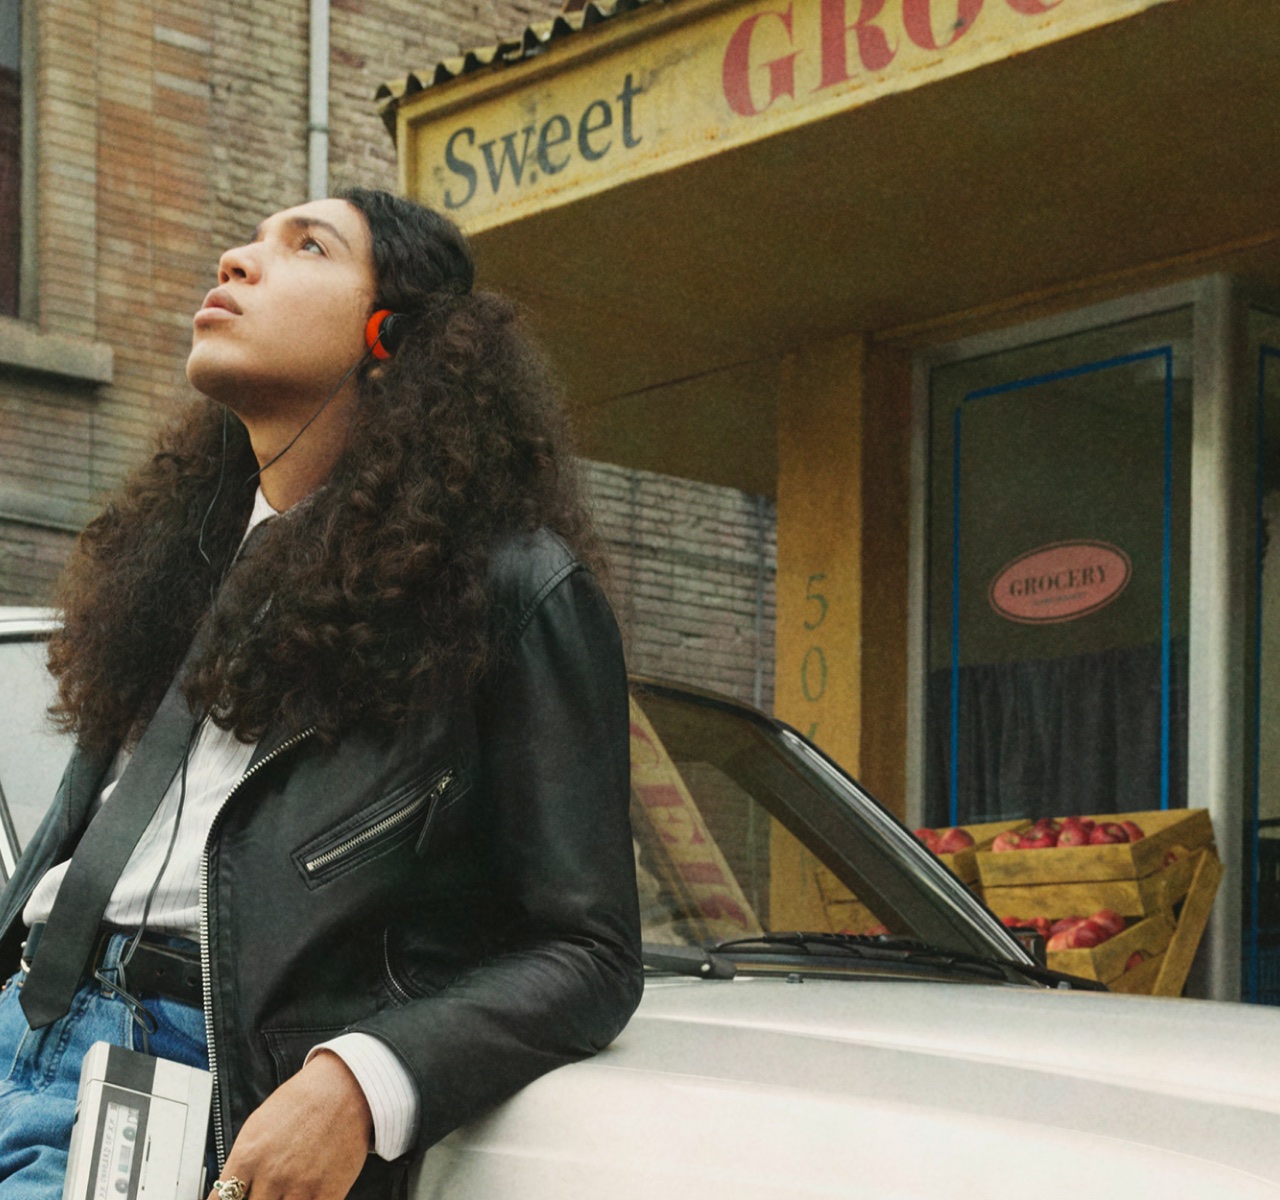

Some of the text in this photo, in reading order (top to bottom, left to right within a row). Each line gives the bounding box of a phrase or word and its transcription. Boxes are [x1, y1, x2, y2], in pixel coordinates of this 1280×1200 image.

[444, 0, 1067, 209] Sweet GRO
[801, 572, 828, 741] 50
[1008, 565, 1107, 597] GROCERY
